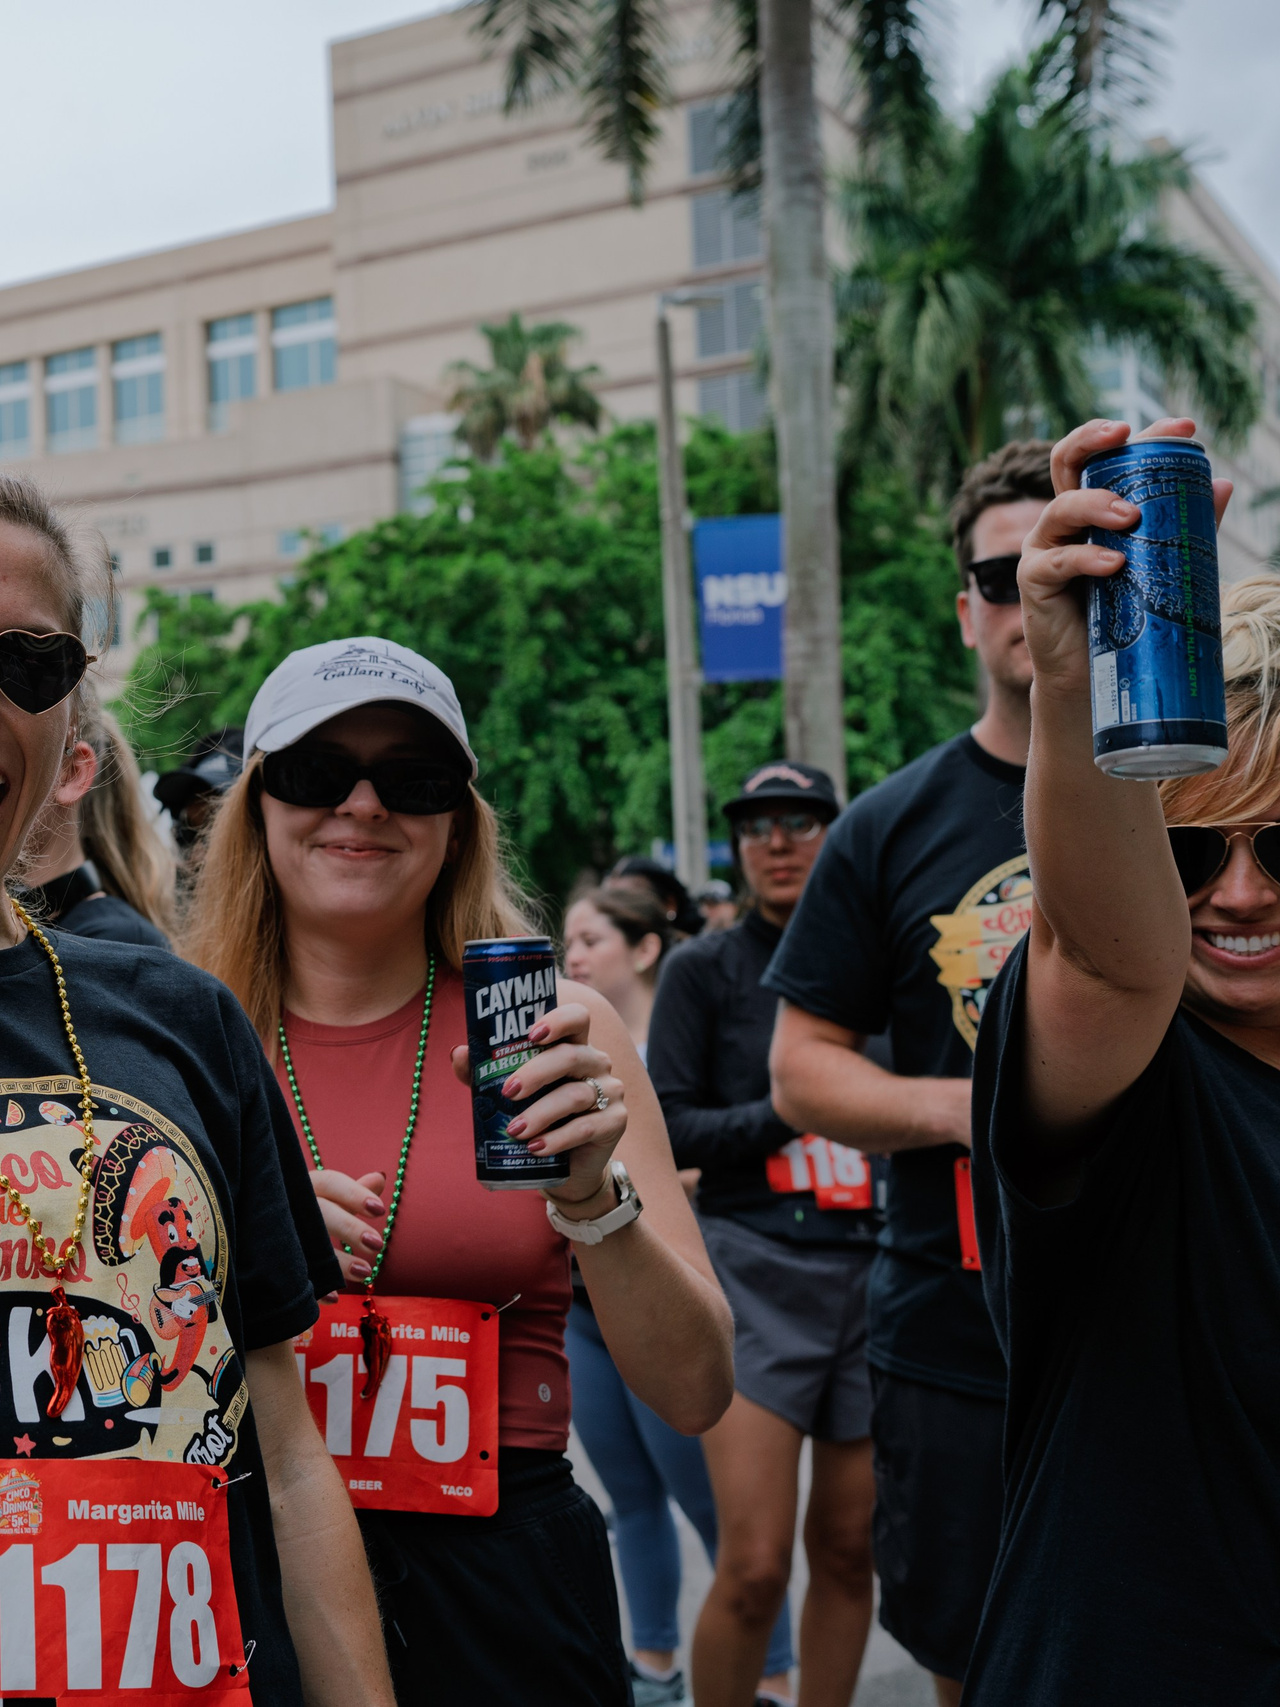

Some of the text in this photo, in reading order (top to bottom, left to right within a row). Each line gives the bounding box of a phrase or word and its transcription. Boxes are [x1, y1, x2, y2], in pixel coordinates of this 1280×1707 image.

[1141, 457, 1180, 465] PROUDLY
[1178, 484, 1188, 524] NECTAR
[1180, 527, 1190, 561] AGAVE
[702, 573, 788, 609] NSU
[1183, 571, 1193, 602] JUICE
[1185, 607, 1194, 634] LIME
[1186, 636, 1195, 664] WITH
[323, 666, 425, 695] Gallant Lady
[1188, 667, 1198, 697] MADE
[475, 966, 555, 1020] CAYMAN
[431, 1325, 471, 1344] Mile
[6, 1487, 30, 1502] CINCO
[349, 1479, 383, 1491] BEER
[441, 1484, 473, 1497] TACO
[2, 1500, 33, 1515] DRINKO
[11, 1514, 24, 1527] 5K
[67, 1499, 206, 1525] Margarita Mile
